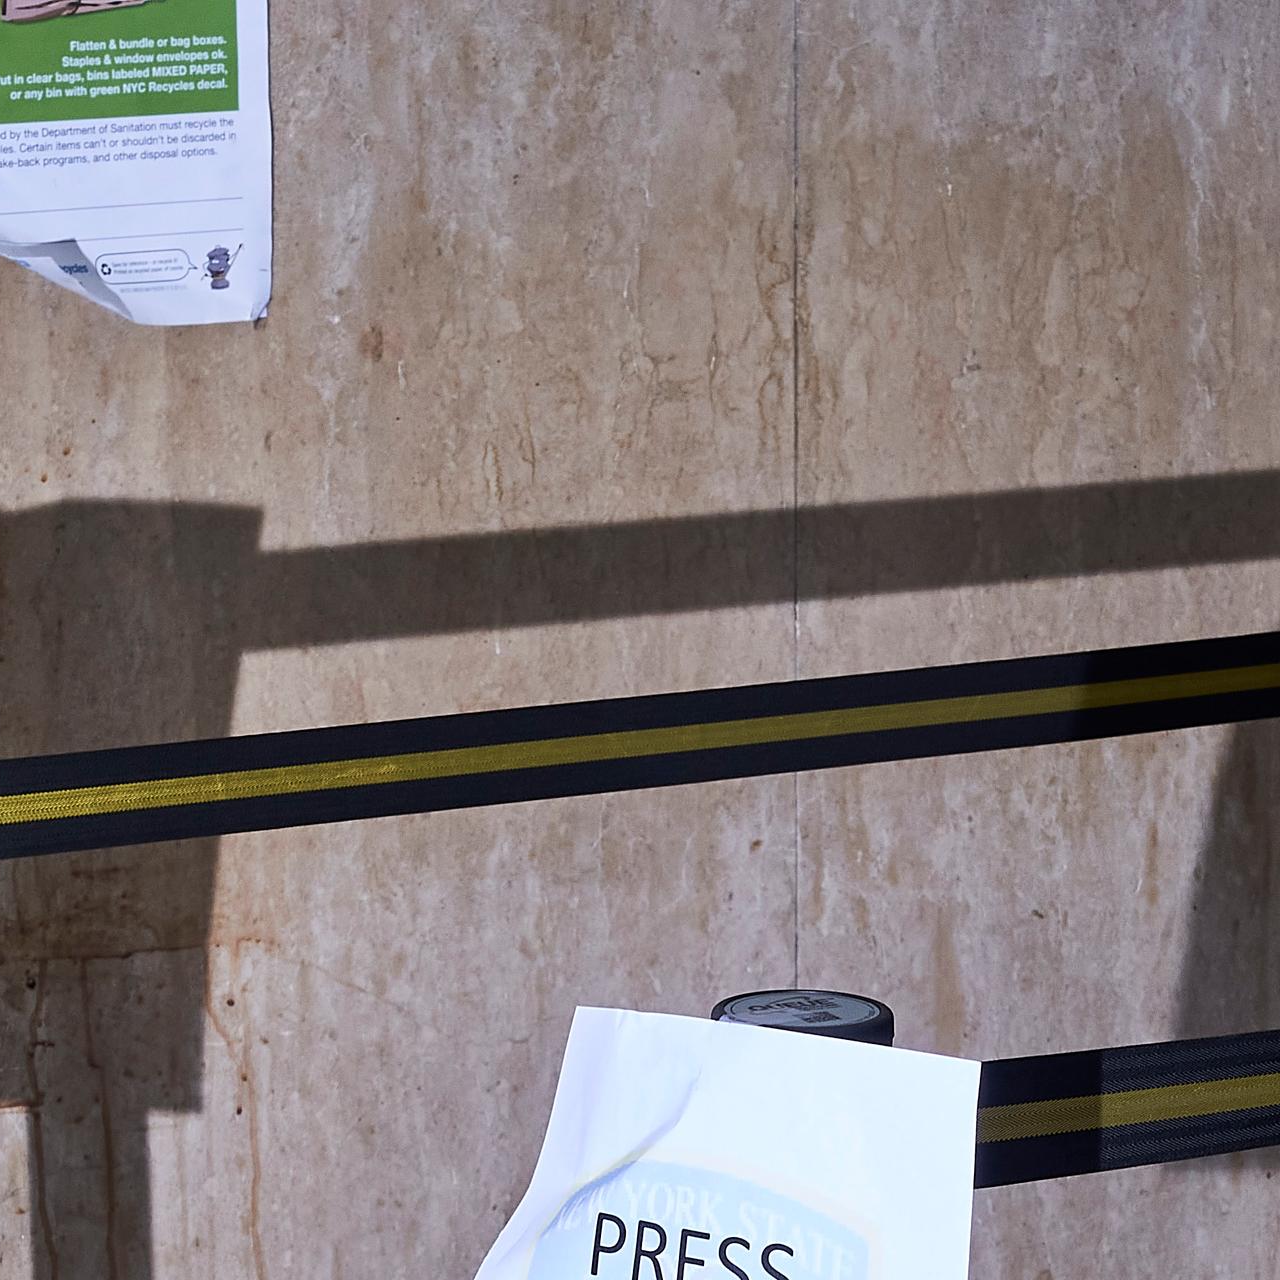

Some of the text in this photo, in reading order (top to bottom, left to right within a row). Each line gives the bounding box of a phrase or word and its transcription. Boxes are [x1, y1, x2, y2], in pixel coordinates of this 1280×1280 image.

[69, 35, 226, 51] Flatten & bundle or bag boxes.
[61, 48, 227, 67] Staples & window envelopes ok.
[13, 74, 24, 84] in
[26, 73, 53, 83] clear
[54, 72, 84, 83] bags,
[86, 70, 109, 80] bins
[111, 67, 149, 79] labeled
[151, 65, 187, 76] MIXED
[188, 63, 228, 74] PAPER,
[9, 78, 228, 100] or any bin with green NYC Recycles decal.
